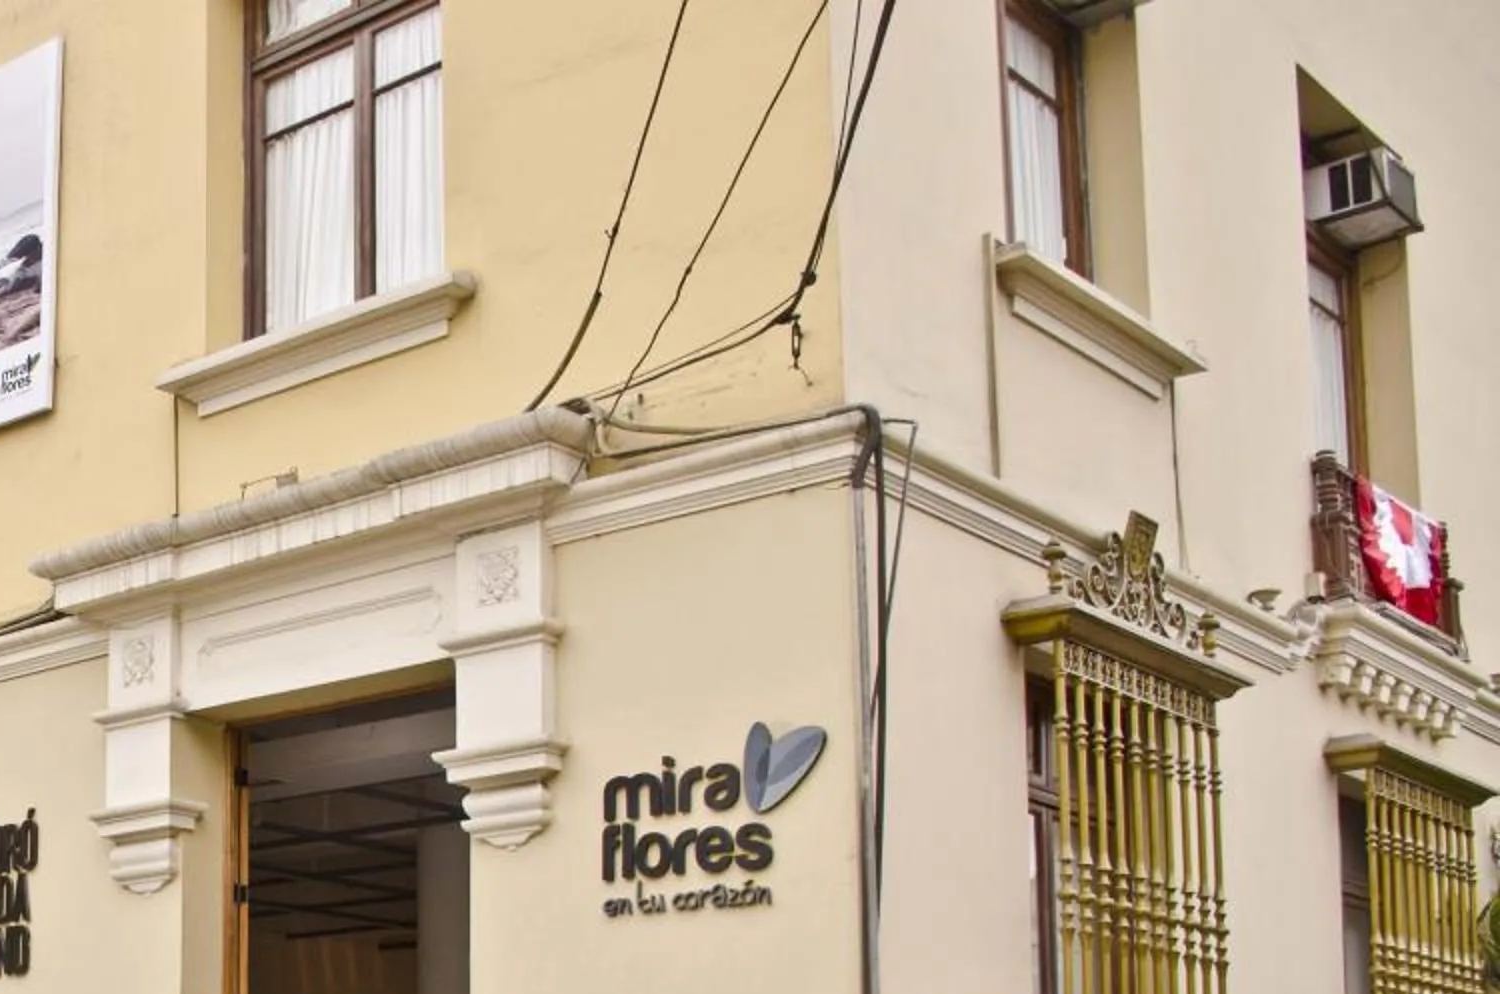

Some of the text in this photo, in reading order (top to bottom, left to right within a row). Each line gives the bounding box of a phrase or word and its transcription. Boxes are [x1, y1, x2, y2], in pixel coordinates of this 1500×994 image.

[603, 755, 741, 823] mira
[602, 822, 774, 882] flores
[603, 880, 773, 918] en tu corazón
